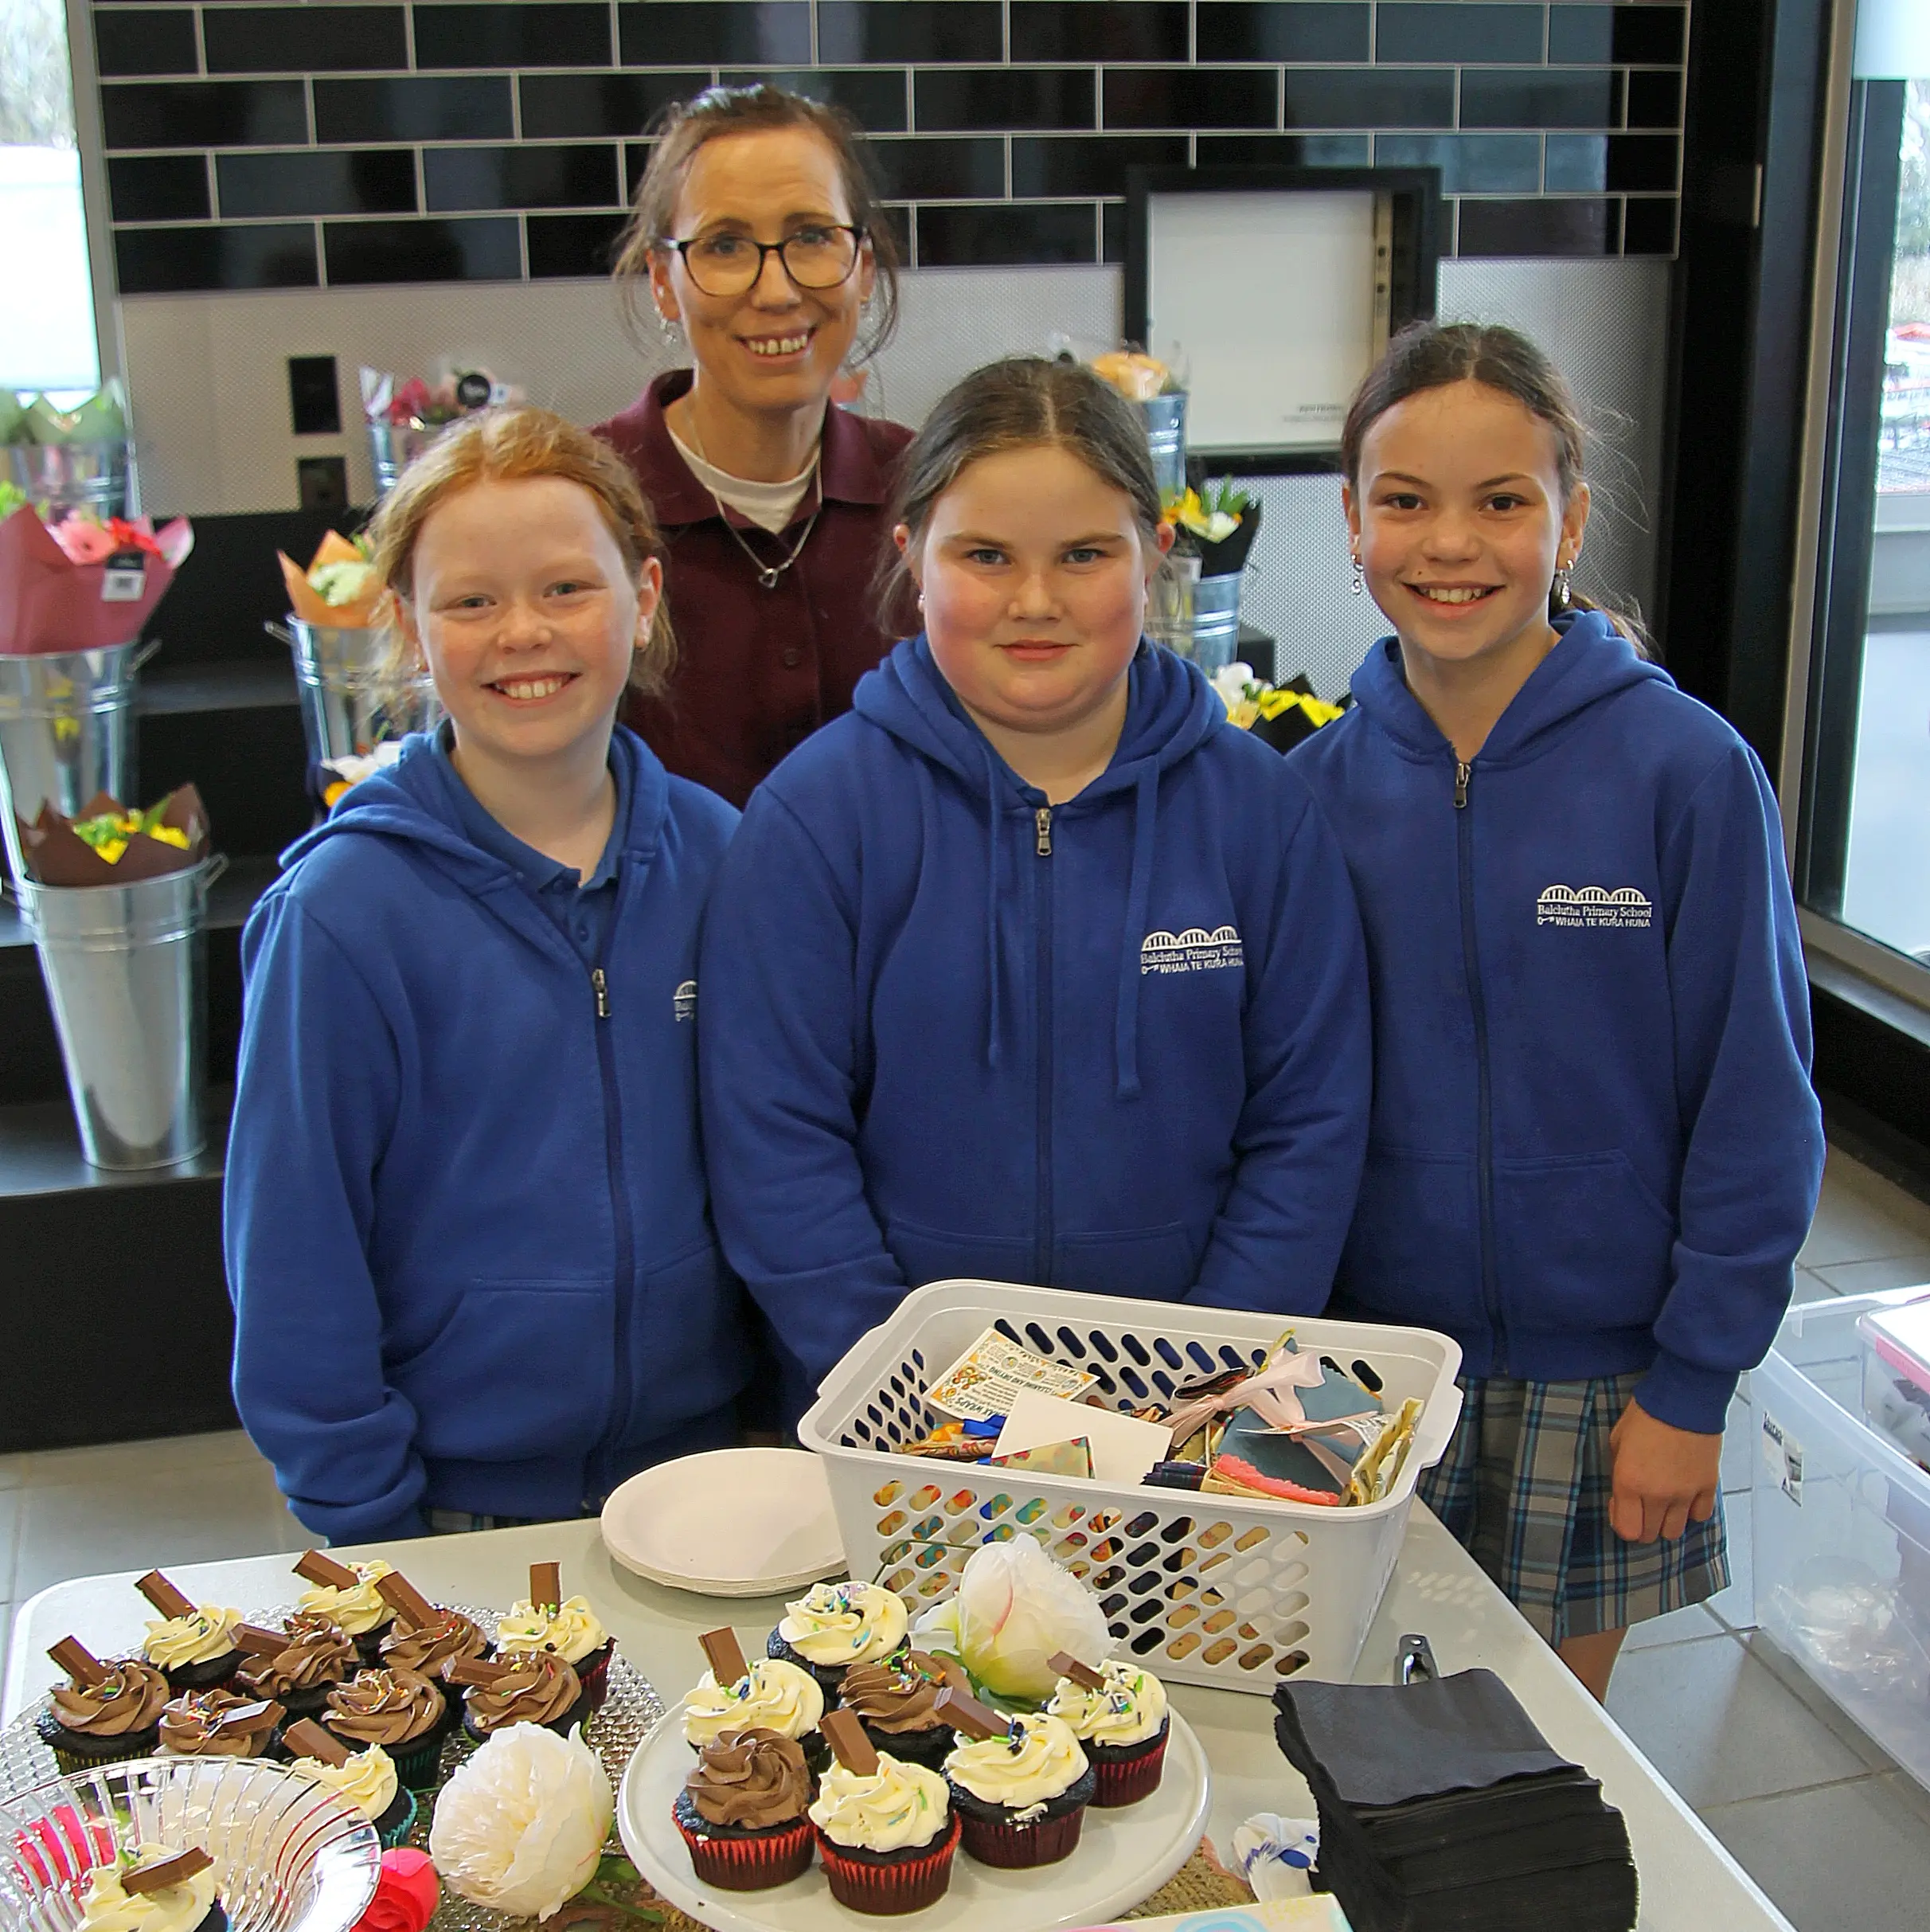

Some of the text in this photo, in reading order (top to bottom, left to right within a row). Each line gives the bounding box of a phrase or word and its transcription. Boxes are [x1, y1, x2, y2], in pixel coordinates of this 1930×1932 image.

[1537, 905, 1652, 919] Balclutha Primary School
[1555, 917, 1584, 926] WHAIA
[1586, 917, 1597, 926] TE
[1599, 917, 1624, 927] KURA
[1191, 961, 1202, 970] TE
[989, 1367, 1013, 1381] DRYING
[1010, 1377, 1026, 1386] AND
[955, 1397, 984, 1413] WRAPS
